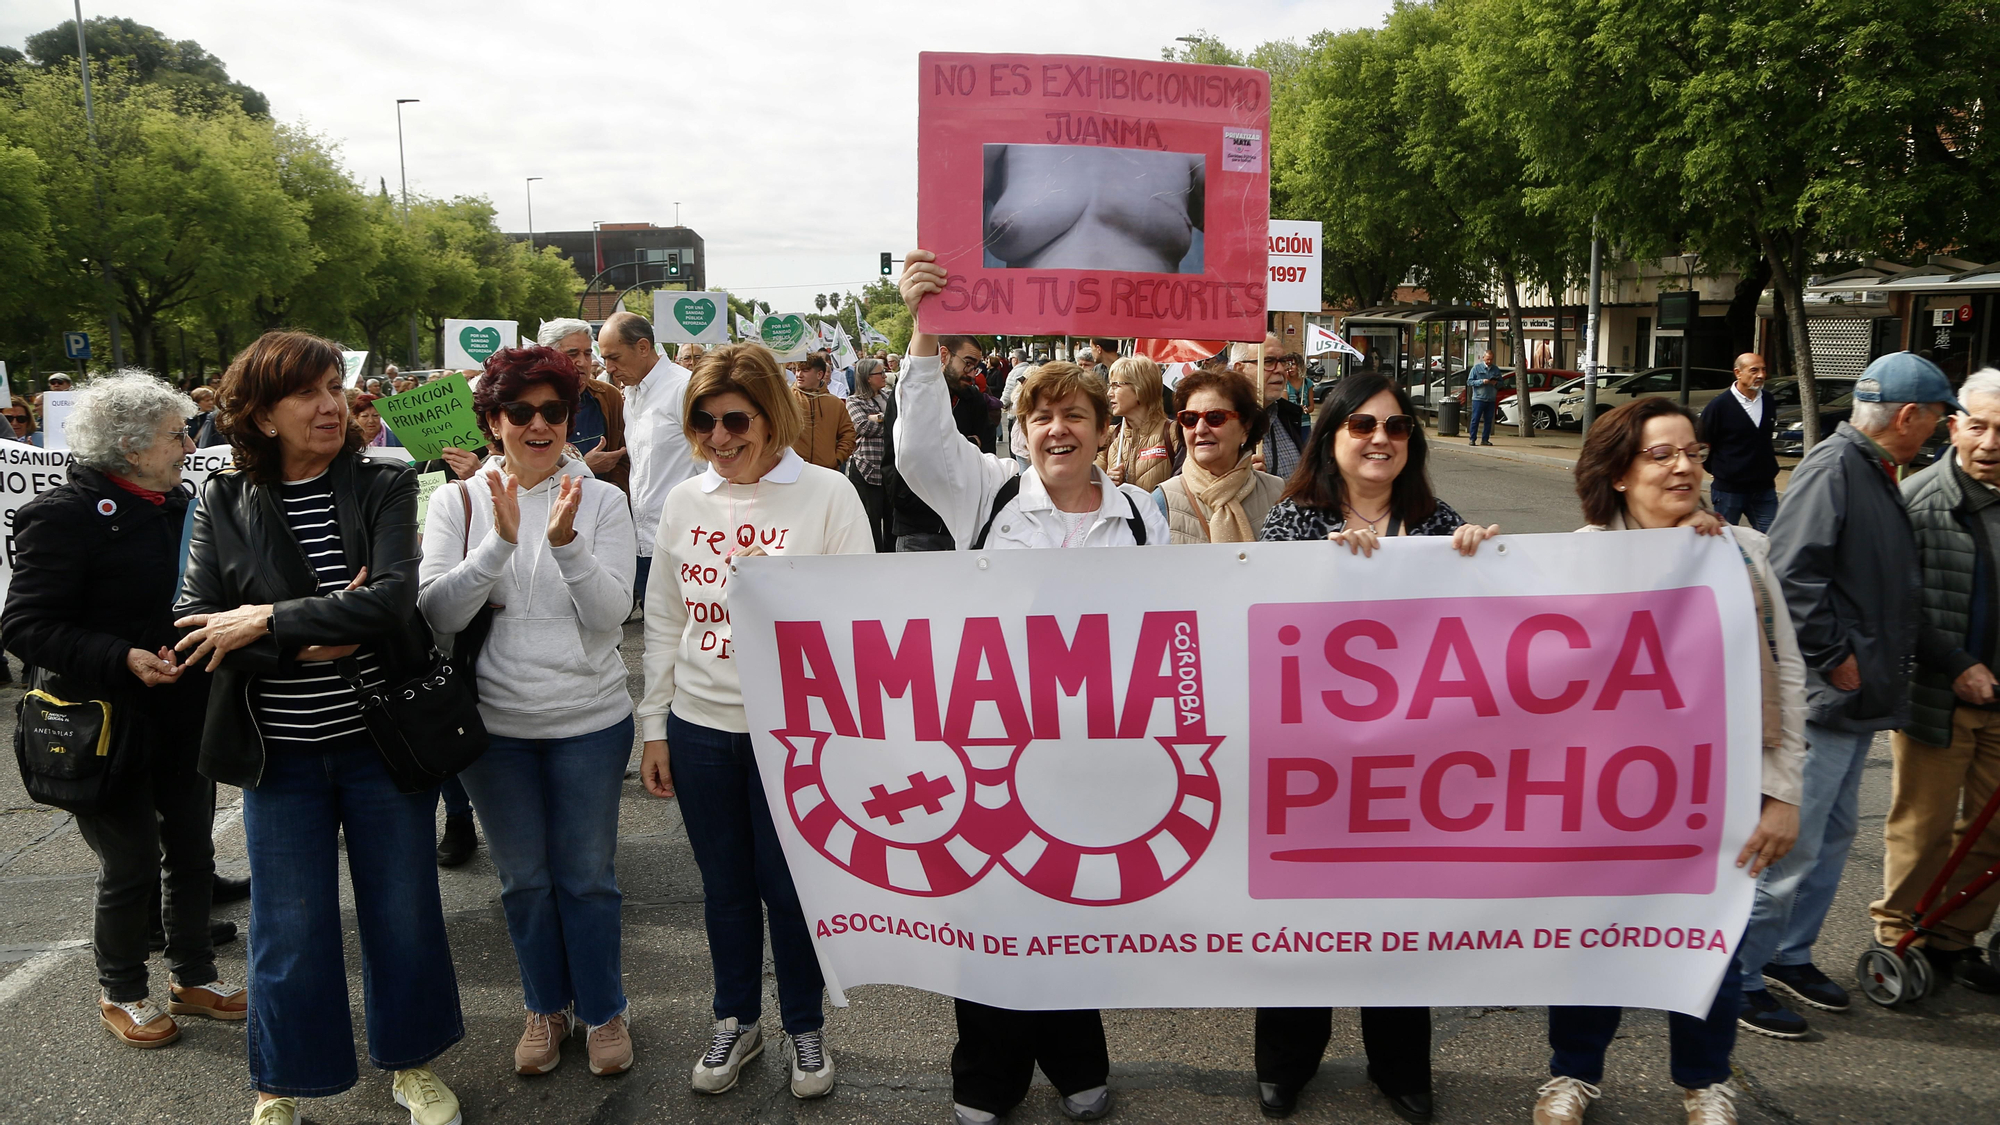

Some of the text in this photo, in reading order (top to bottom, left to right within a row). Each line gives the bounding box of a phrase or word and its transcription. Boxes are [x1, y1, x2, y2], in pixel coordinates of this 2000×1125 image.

[934, 63, 1262, 112] NO ES EXHIBICIONISMO
[1045, 112, 1168, 151] JUANMA,
[1268, 265, 1307, 283] 1997
[941, 275, 1265, 321] SON TUS RECORTES
[1961, 307, 1969, 319] 2
[69, 335, 85, 355] P
[387, 382, 454, 412] ATENCIÓN
[392, 397, 463, 429] PRIMARIA
[418, 430, 480, 455] VIDAS
[421, 421, 453, 437] SALVA
[681, 563, 727, 588] PRO
[700, 630, 735, 660] DI
[774, 610, 1207, 742] AMAMA
[1174, 621, 1202, 727] CÓRDOBA
[1277, 609, 1687, 724] ¡SACA
[1266, 742, 1713, 836] PECHO!
[816, 912, 1729, 957] ASOCIACIÓN DE AFECTADAS DE CÁNCER DE MAMA DE CÓRDOBA
